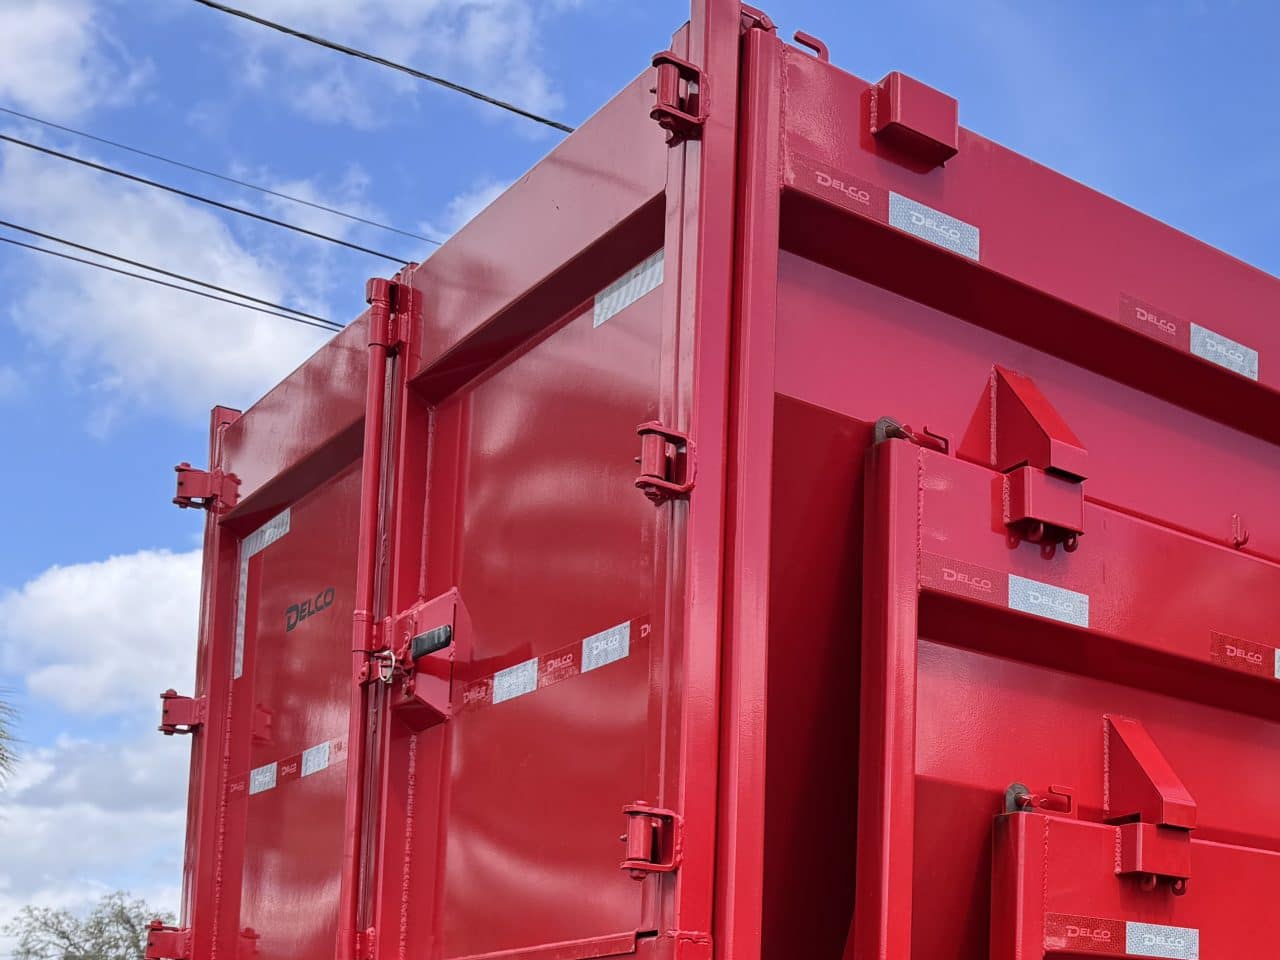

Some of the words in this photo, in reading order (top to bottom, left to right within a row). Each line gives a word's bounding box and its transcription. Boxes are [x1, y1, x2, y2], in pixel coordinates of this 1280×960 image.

[815, 171, 870, 201] DELCO
[910, 210, 961, 239] DELCO
[1134, 307, 1177, 333] DELCO
[942, 567, 993, 590] DELCO
[286, 587, 335, 632] DELCO
[1225, 644, 1264, 664] DELCO
[1065, 925, 1111, 940] DELCO
